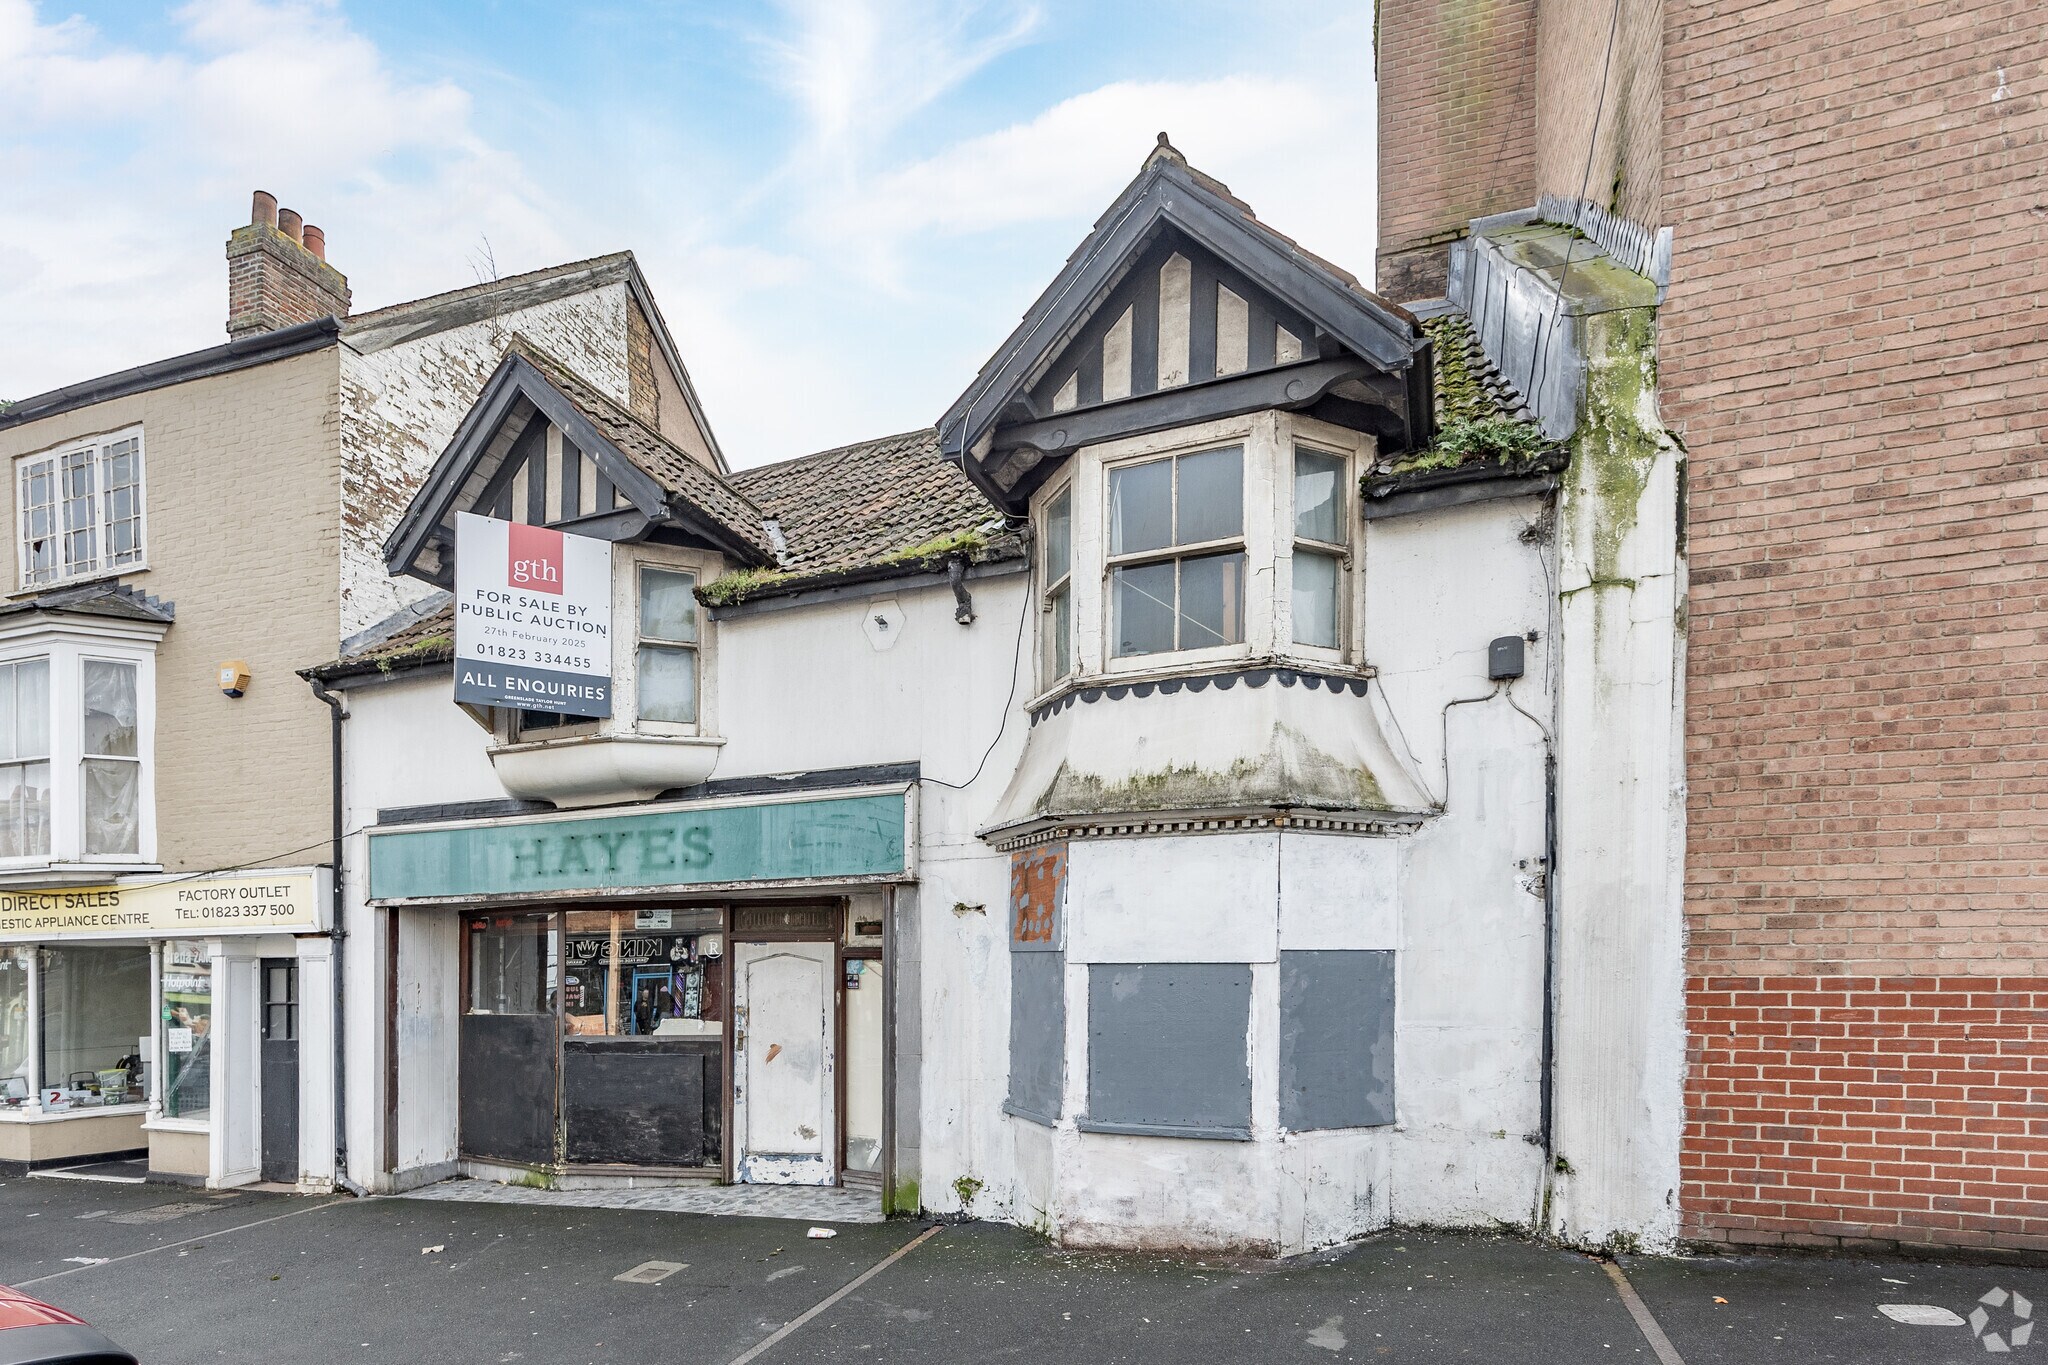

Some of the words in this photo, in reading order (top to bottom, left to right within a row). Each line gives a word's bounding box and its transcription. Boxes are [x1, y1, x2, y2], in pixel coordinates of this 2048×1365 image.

[514, 559, 558, 583] gth
[476, 590, 511, 605] FOR
[519, 597, 559, 613] SALE
[567, 605, 588, 617] BY
[461, 603, 523, 623] PUBLIC
[530, 615, 607, 635] AUCTION
[484, 626, 508, 637] 27th
[512, 630, 558, 646] February
[562, 638, 586, 649] 2025
[476, 643, 526, 660] 01823
[534, 652, 591, 668] 334455
[462, 671, 497, 688] ALL
[505, 677, 606, 701] ENQUIRIES
[504, 694, 535, 703] GREENSLADE
[517, 702, 555, 710] www.gth.net
[509, 825, 714, 882] HAYES
[2, 894, 60, 912] DIRECT
[65, 891, 120, 909] SALES
[178, 888, 236, 901] FACTORY
[239, 885, 291, 899] OUTLET
[0, 918, 32, 930] ESTIC
[34, 915, 99, 928] APPLIANCE
[101, 912, 150, 925] CENTRE
[202, 906, 240, 918] 01823
[243, 905, 266, 917] 337
[270, 904, 295, 916] 500
[161, 974, 206, 990] Hotpoint
